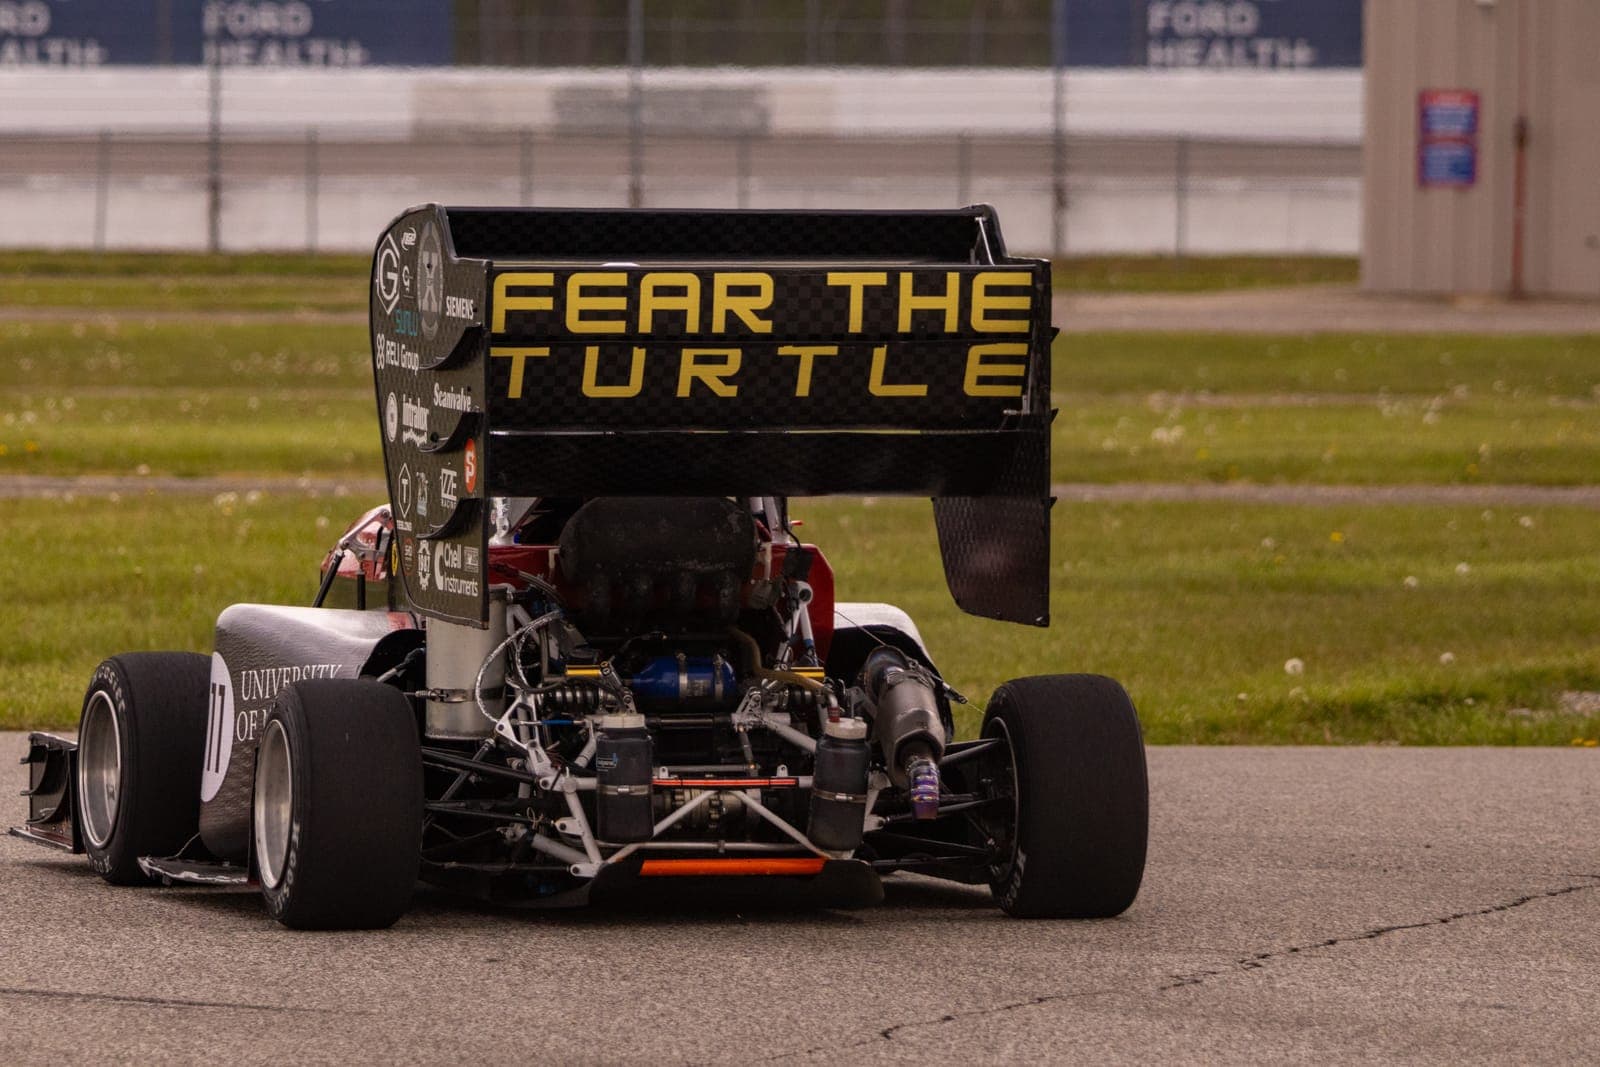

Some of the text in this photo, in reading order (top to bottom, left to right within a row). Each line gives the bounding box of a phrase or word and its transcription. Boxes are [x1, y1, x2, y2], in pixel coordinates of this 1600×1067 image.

[202, 1, 313, 37] FORD
[1147, 1, 1259, 36] FORD
[445, 295, 475, 321] SIEMENS
[492, 272, 1033, 334] FEAR THE
[400, 344, 419, 376] Group
[490, 344, 1028, 398] TURTLE
[433, 382, 472, 412] Scanivalve
[444, 543, 462, 569] Chell
[236, 709, 258, 741] OF
